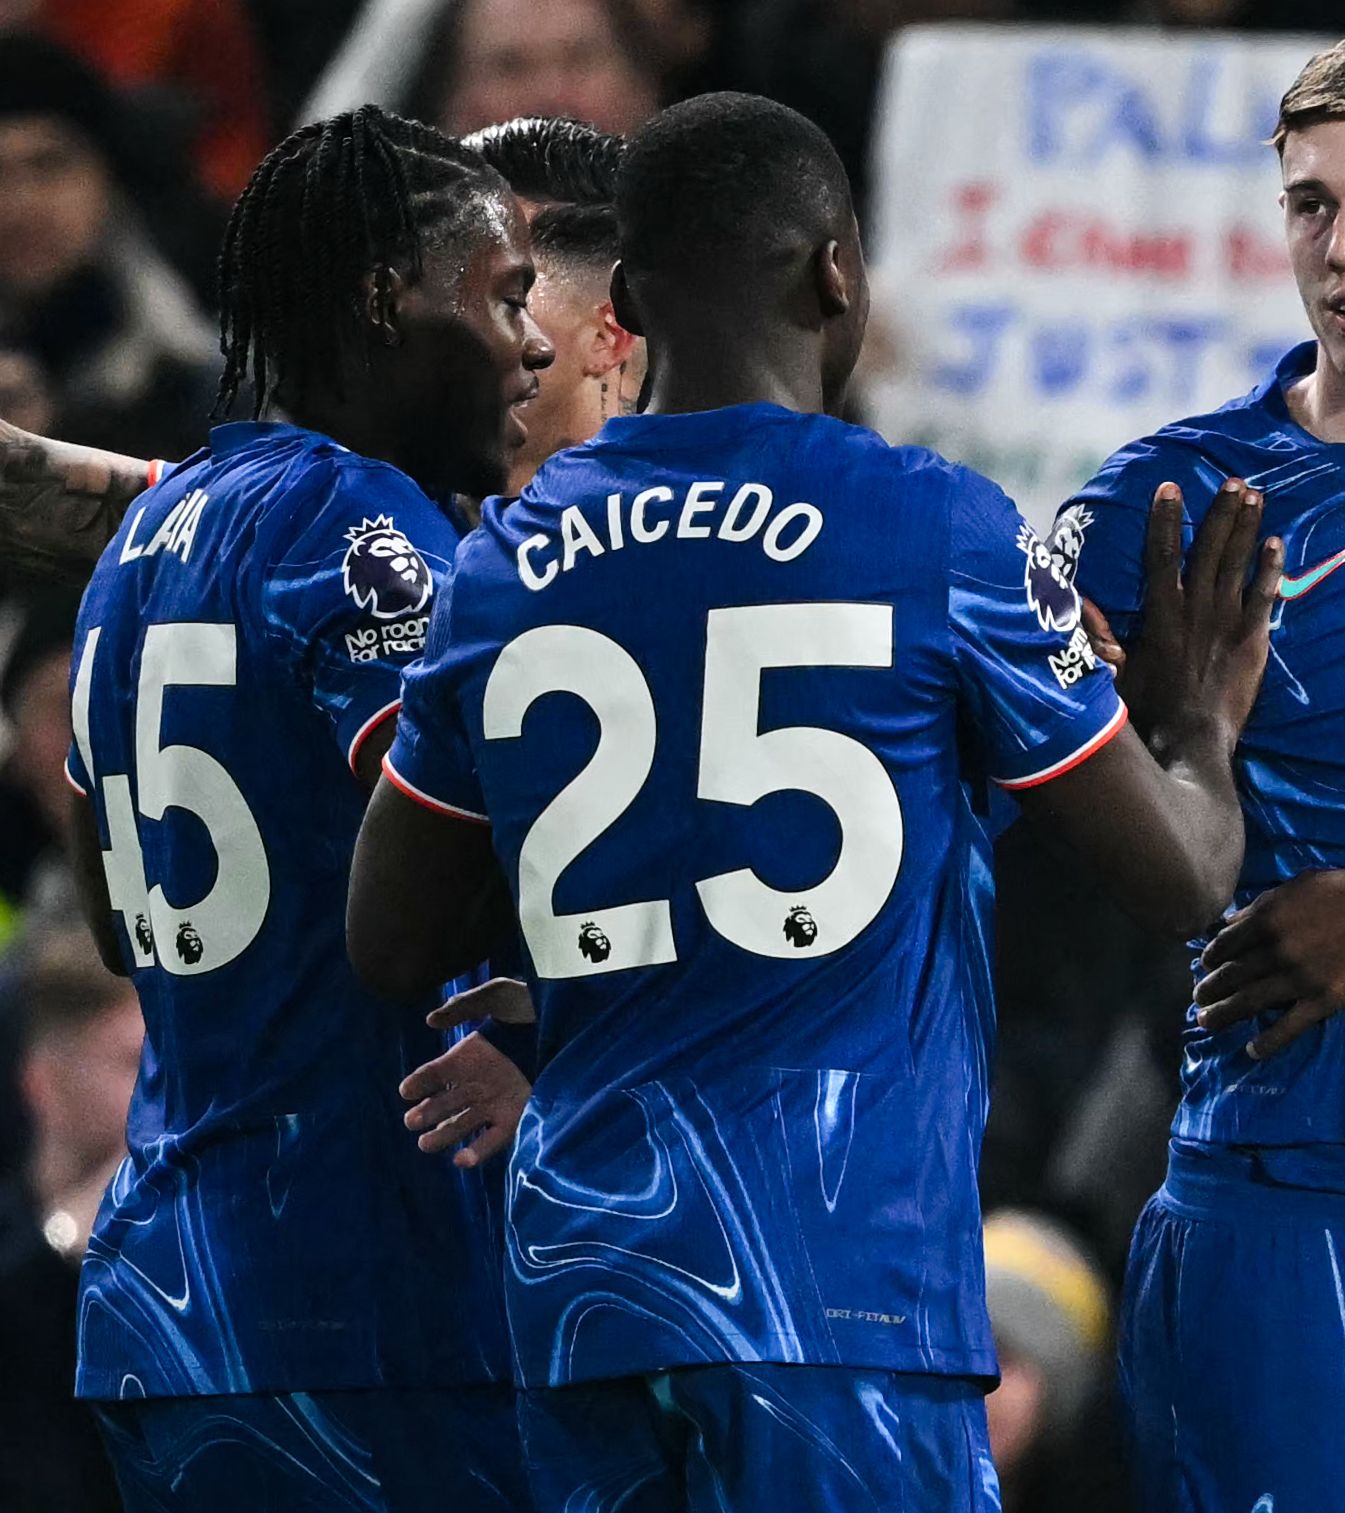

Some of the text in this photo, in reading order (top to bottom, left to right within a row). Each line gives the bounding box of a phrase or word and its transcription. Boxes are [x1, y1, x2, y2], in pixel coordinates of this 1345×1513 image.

[1025, 52, 1284, 168] PAL
[517, 481, 824, 591] CAICEDO
[344, 628, 378, 659] No
[71, 622, 272, 976] 45
[482, 602, 904, 980] 25
